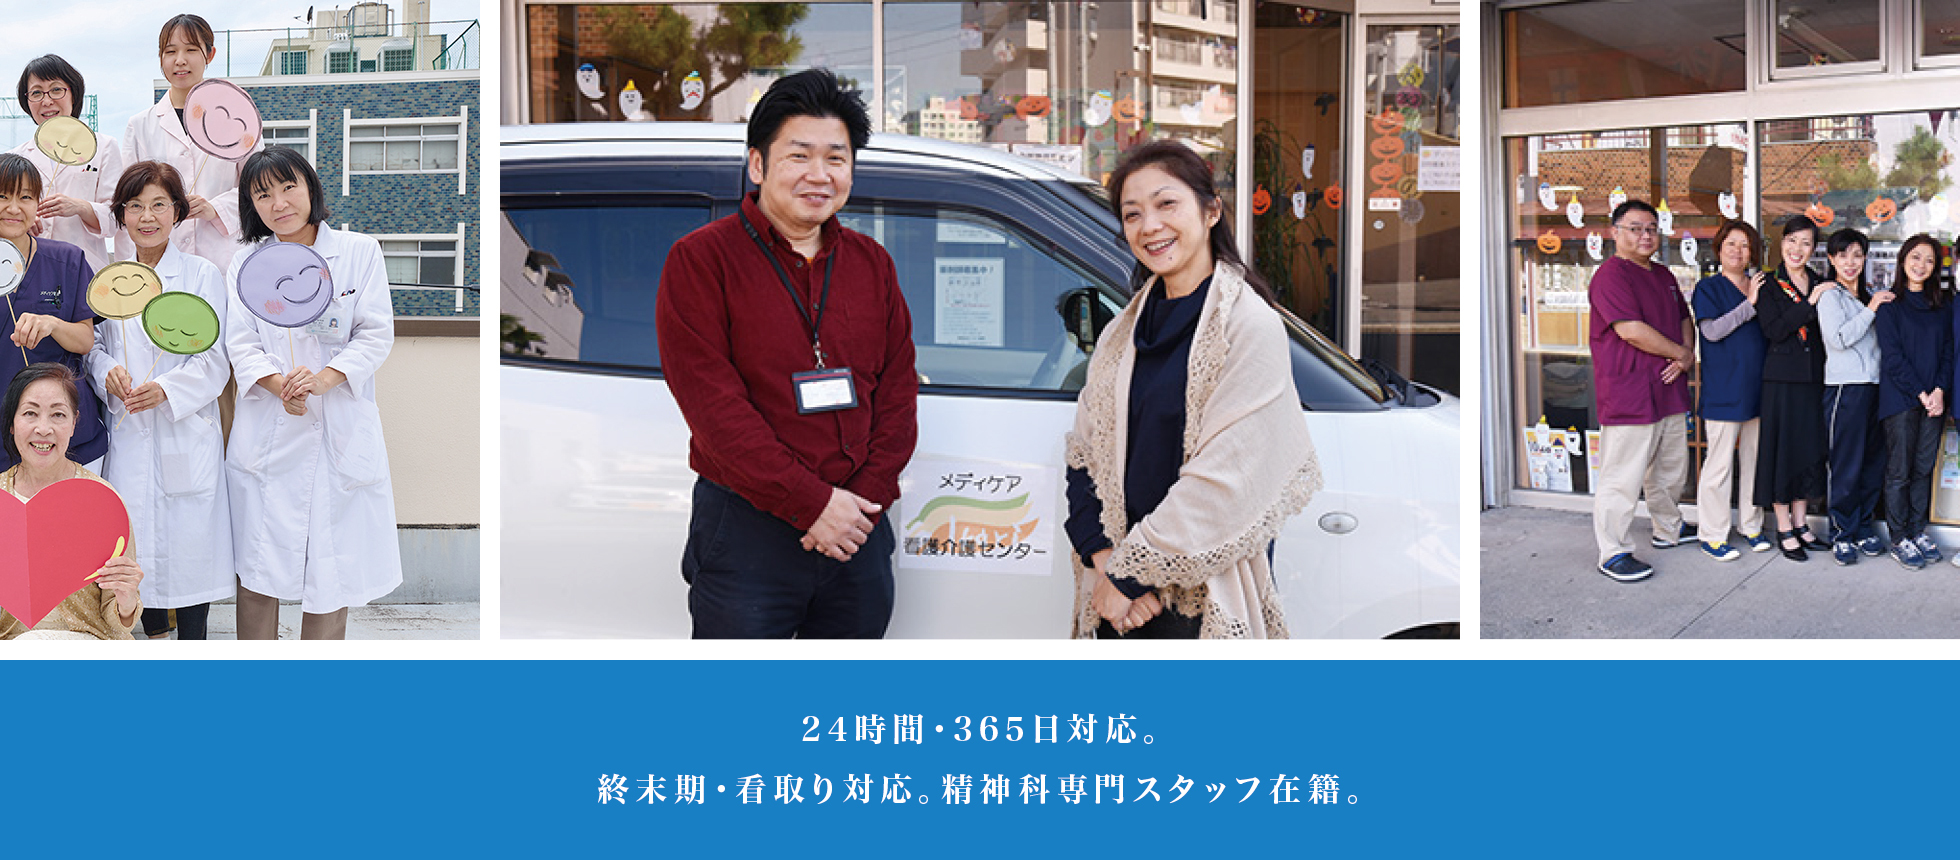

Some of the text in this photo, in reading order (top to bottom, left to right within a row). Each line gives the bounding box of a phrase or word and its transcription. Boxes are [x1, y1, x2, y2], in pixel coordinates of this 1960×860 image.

[938, 472, 1022, 494] メディケア
[904, 537, 1047, 560] 看護介護センター
